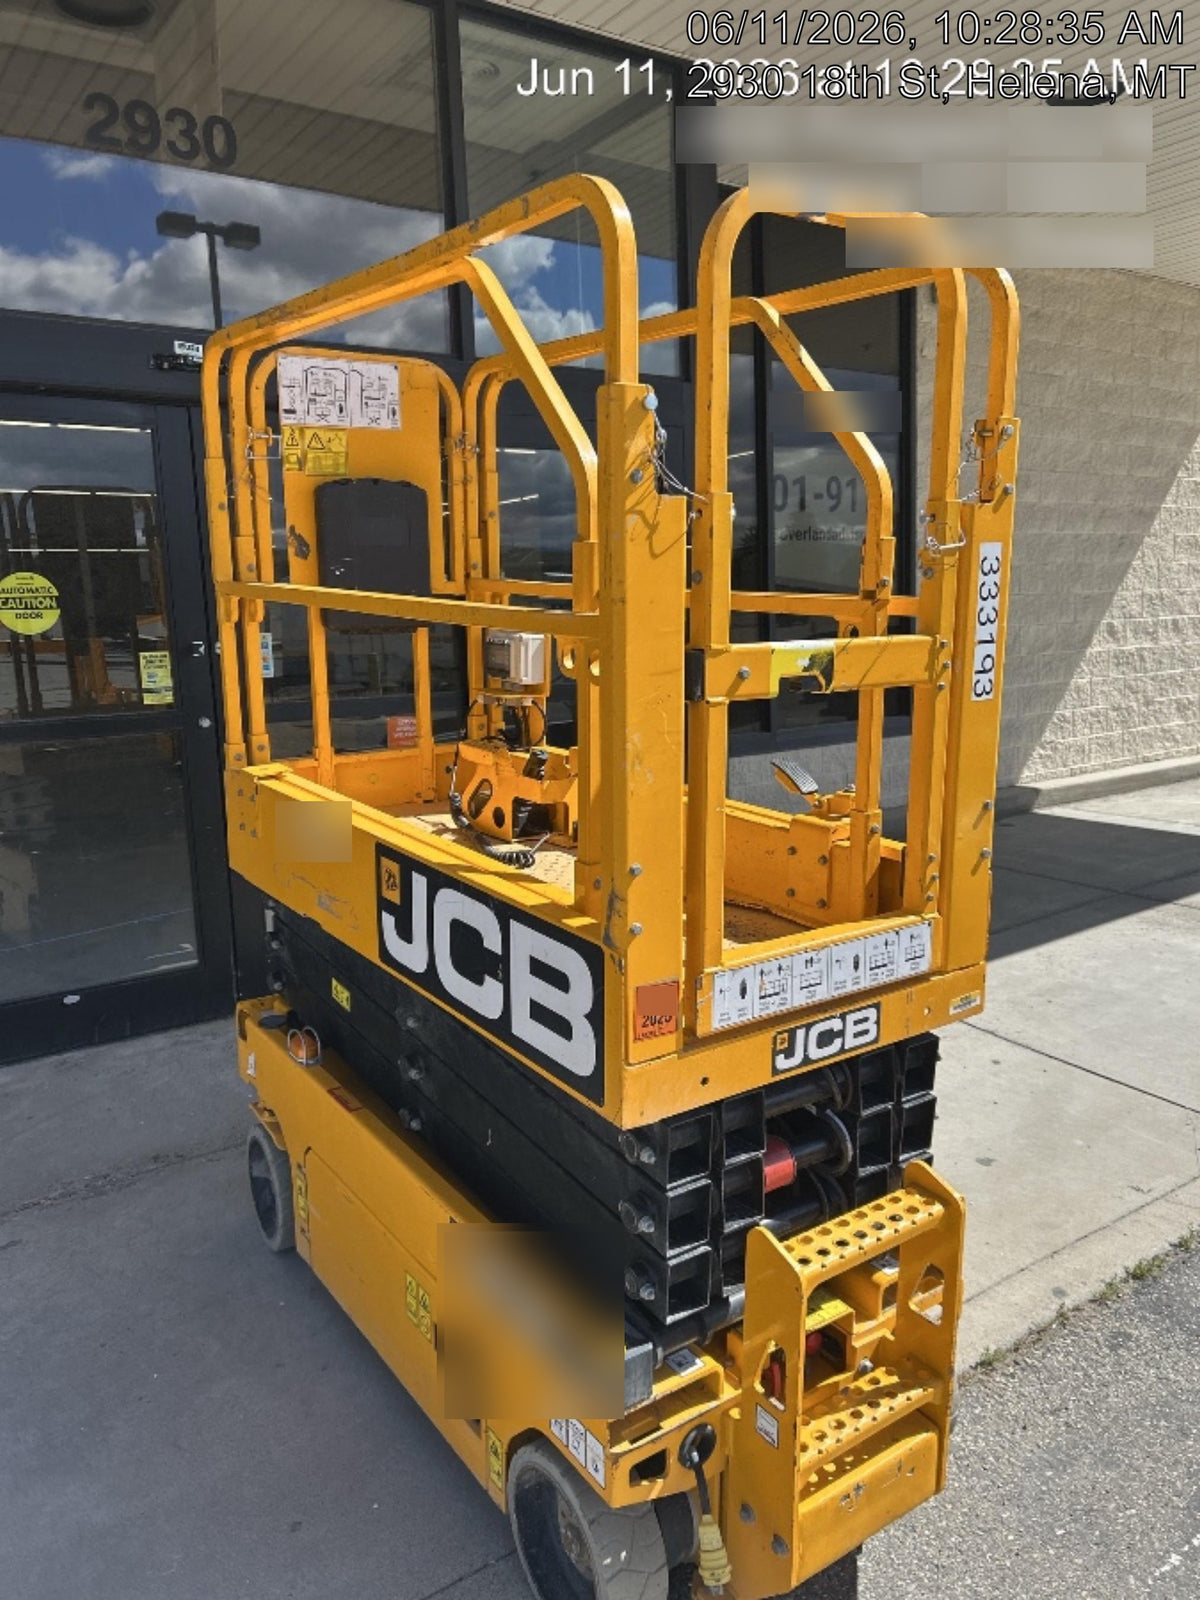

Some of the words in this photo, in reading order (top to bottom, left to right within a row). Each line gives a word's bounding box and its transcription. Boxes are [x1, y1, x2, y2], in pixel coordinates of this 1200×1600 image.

[82, 92, 237, 167] 2930
[0, 597, 57, 609] CAUTION
[974, 556, 1000, 698] 333193
[381, 870, 597, 1077] JCB
[774, 1007, 879, 1071] JCB
